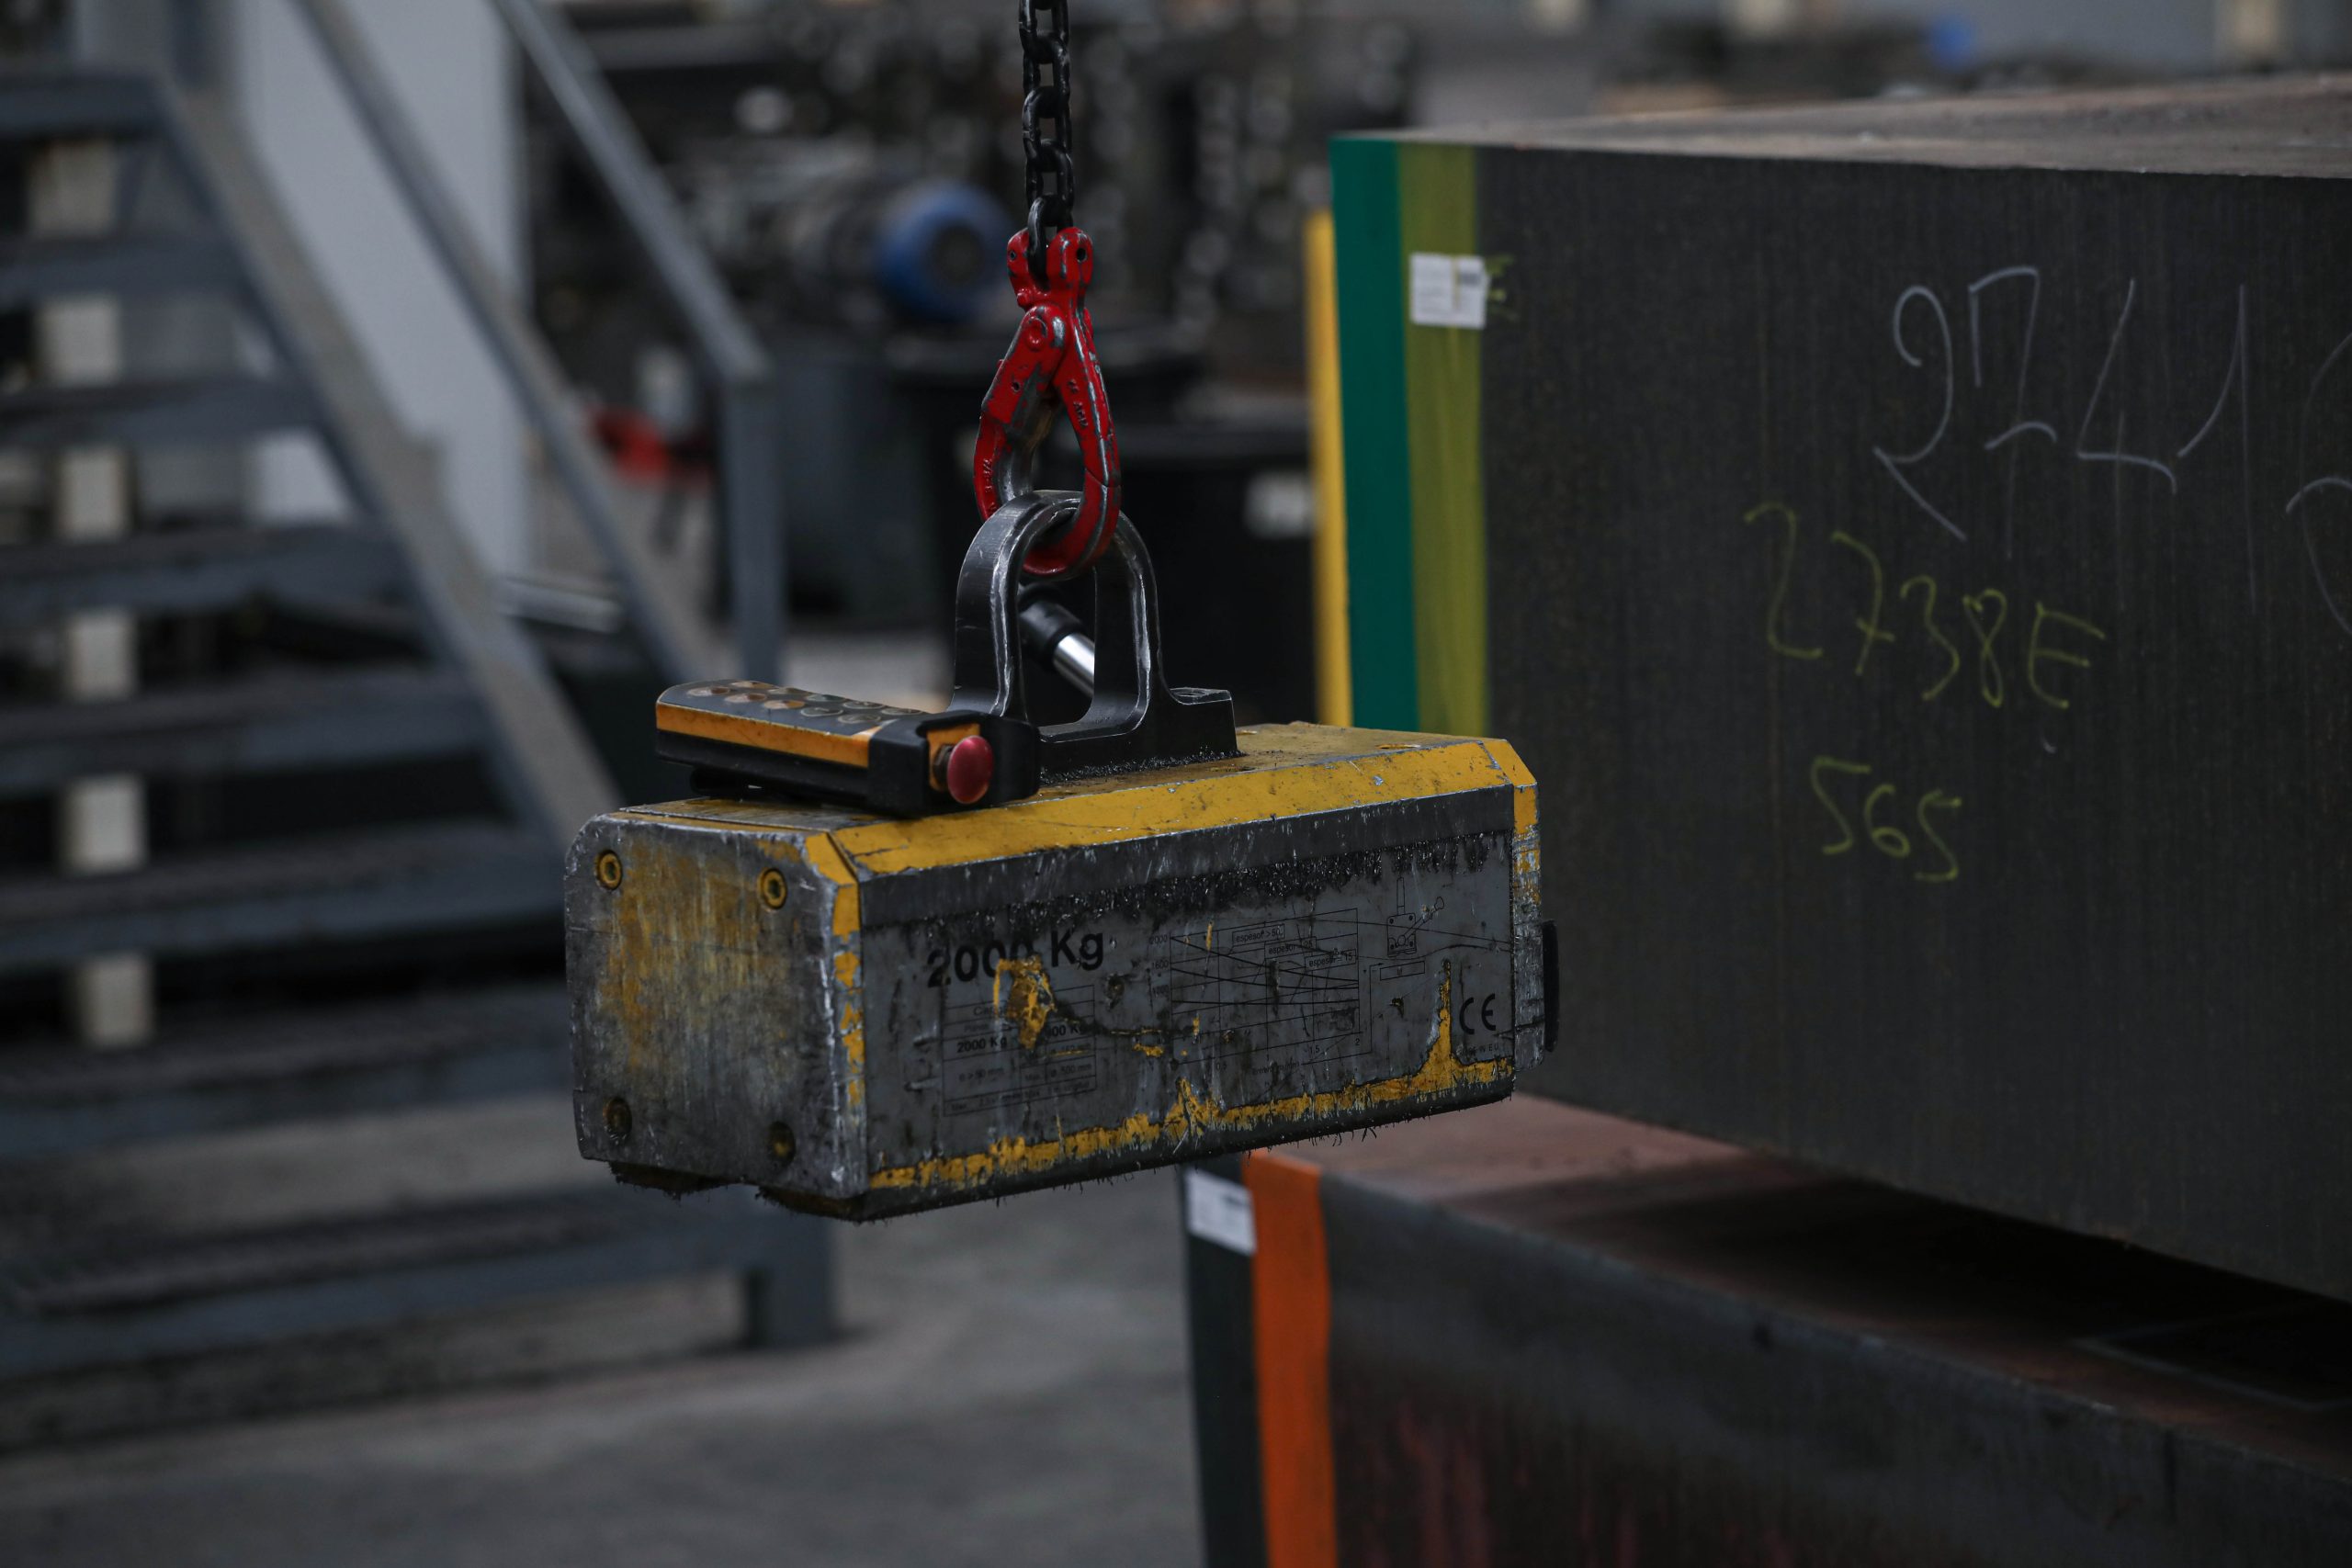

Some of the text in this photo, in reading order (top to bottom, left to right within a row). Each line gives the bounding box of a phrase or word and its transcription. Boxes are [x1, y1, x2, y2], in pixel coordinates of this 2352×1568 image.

[1051, 927, 1103, 972] Kg
[1459, 993, 1497, 1035] CE
[956, 1038, 987, 1054] 2000
[1354, 1037, 1361, 1046] 2
